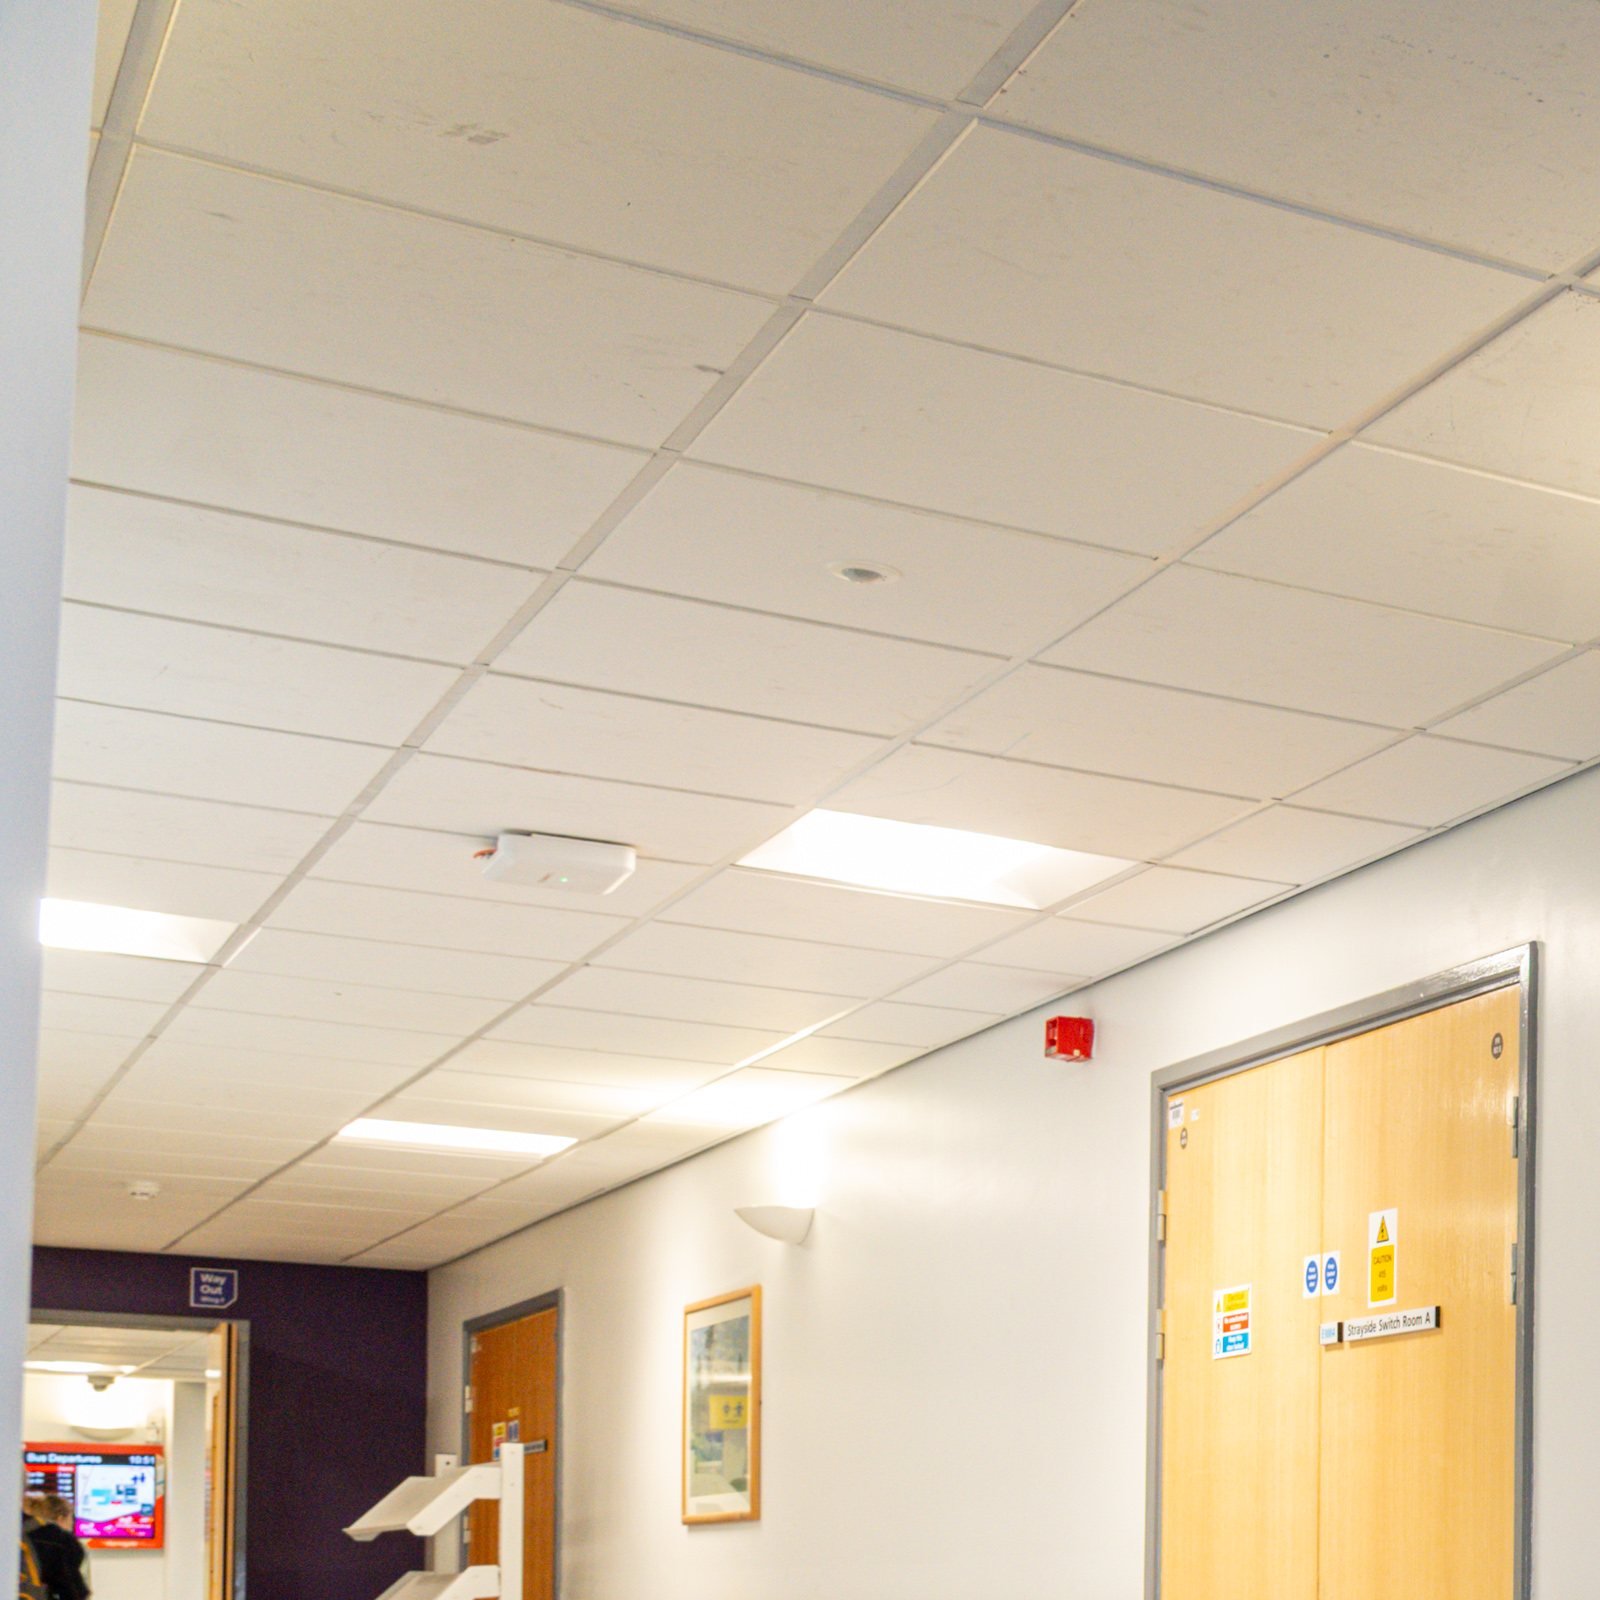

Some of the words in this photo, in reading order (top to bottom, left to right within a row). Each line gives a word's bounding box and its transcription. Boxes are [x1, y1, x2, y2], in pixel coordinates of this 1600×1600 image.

[1373, 1254, 1392, 1264] CAUTION
[200, 1273, 227, 1285] Way
[200, 1284, 222, 1295] Out
[1377, 1284, 1387, 1292] volts
[1347, 1320, 1376, 1337] Strayside
[1379, 1316, 1400, 1332] Switch
[1402, 1315, 1422, 1328] Room
[1425, 1312, 1431, 1324] A
[26, 1452, 47, 1463] Bus
[48, 1453, 102, 1464] Departures
